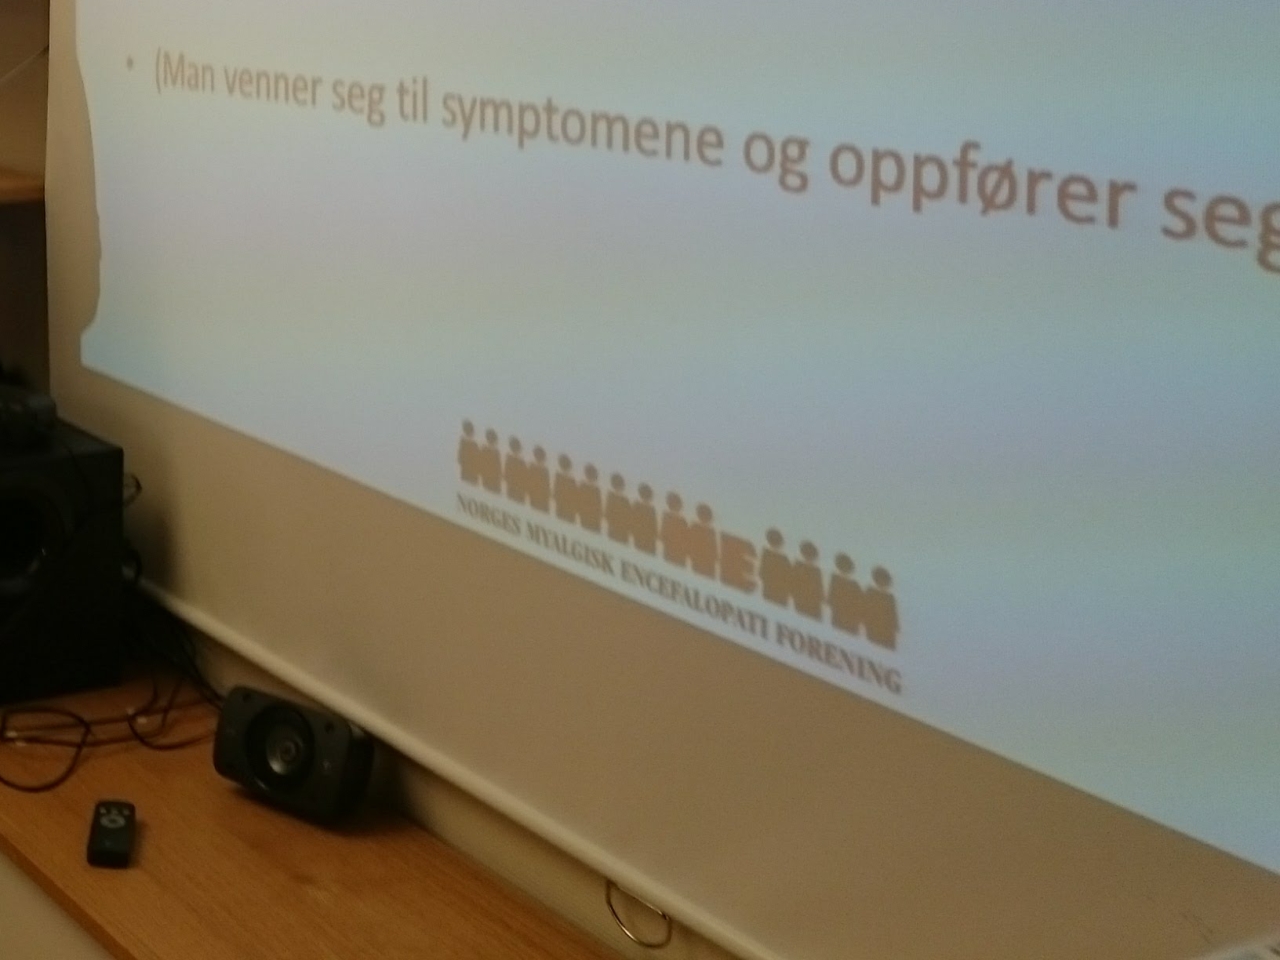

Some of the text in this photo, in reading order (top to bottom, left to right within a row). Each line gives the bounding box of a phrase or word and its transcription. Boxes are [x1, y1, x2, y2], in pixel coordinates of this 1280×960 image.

[154, 46, 216, 95] (Man
[222, 63, 324, 107] venner
[331, 77, 386, 128] seg
[395, 74, 430, 124] til
[441, 89, 725, 168] symptomene
[742, 129, 811, 195] og
[828, 139, 1138, 231] oppfører
[456, 491, 903, 695] NORGES MYALGISK ENCEFALOPATI FORENING
